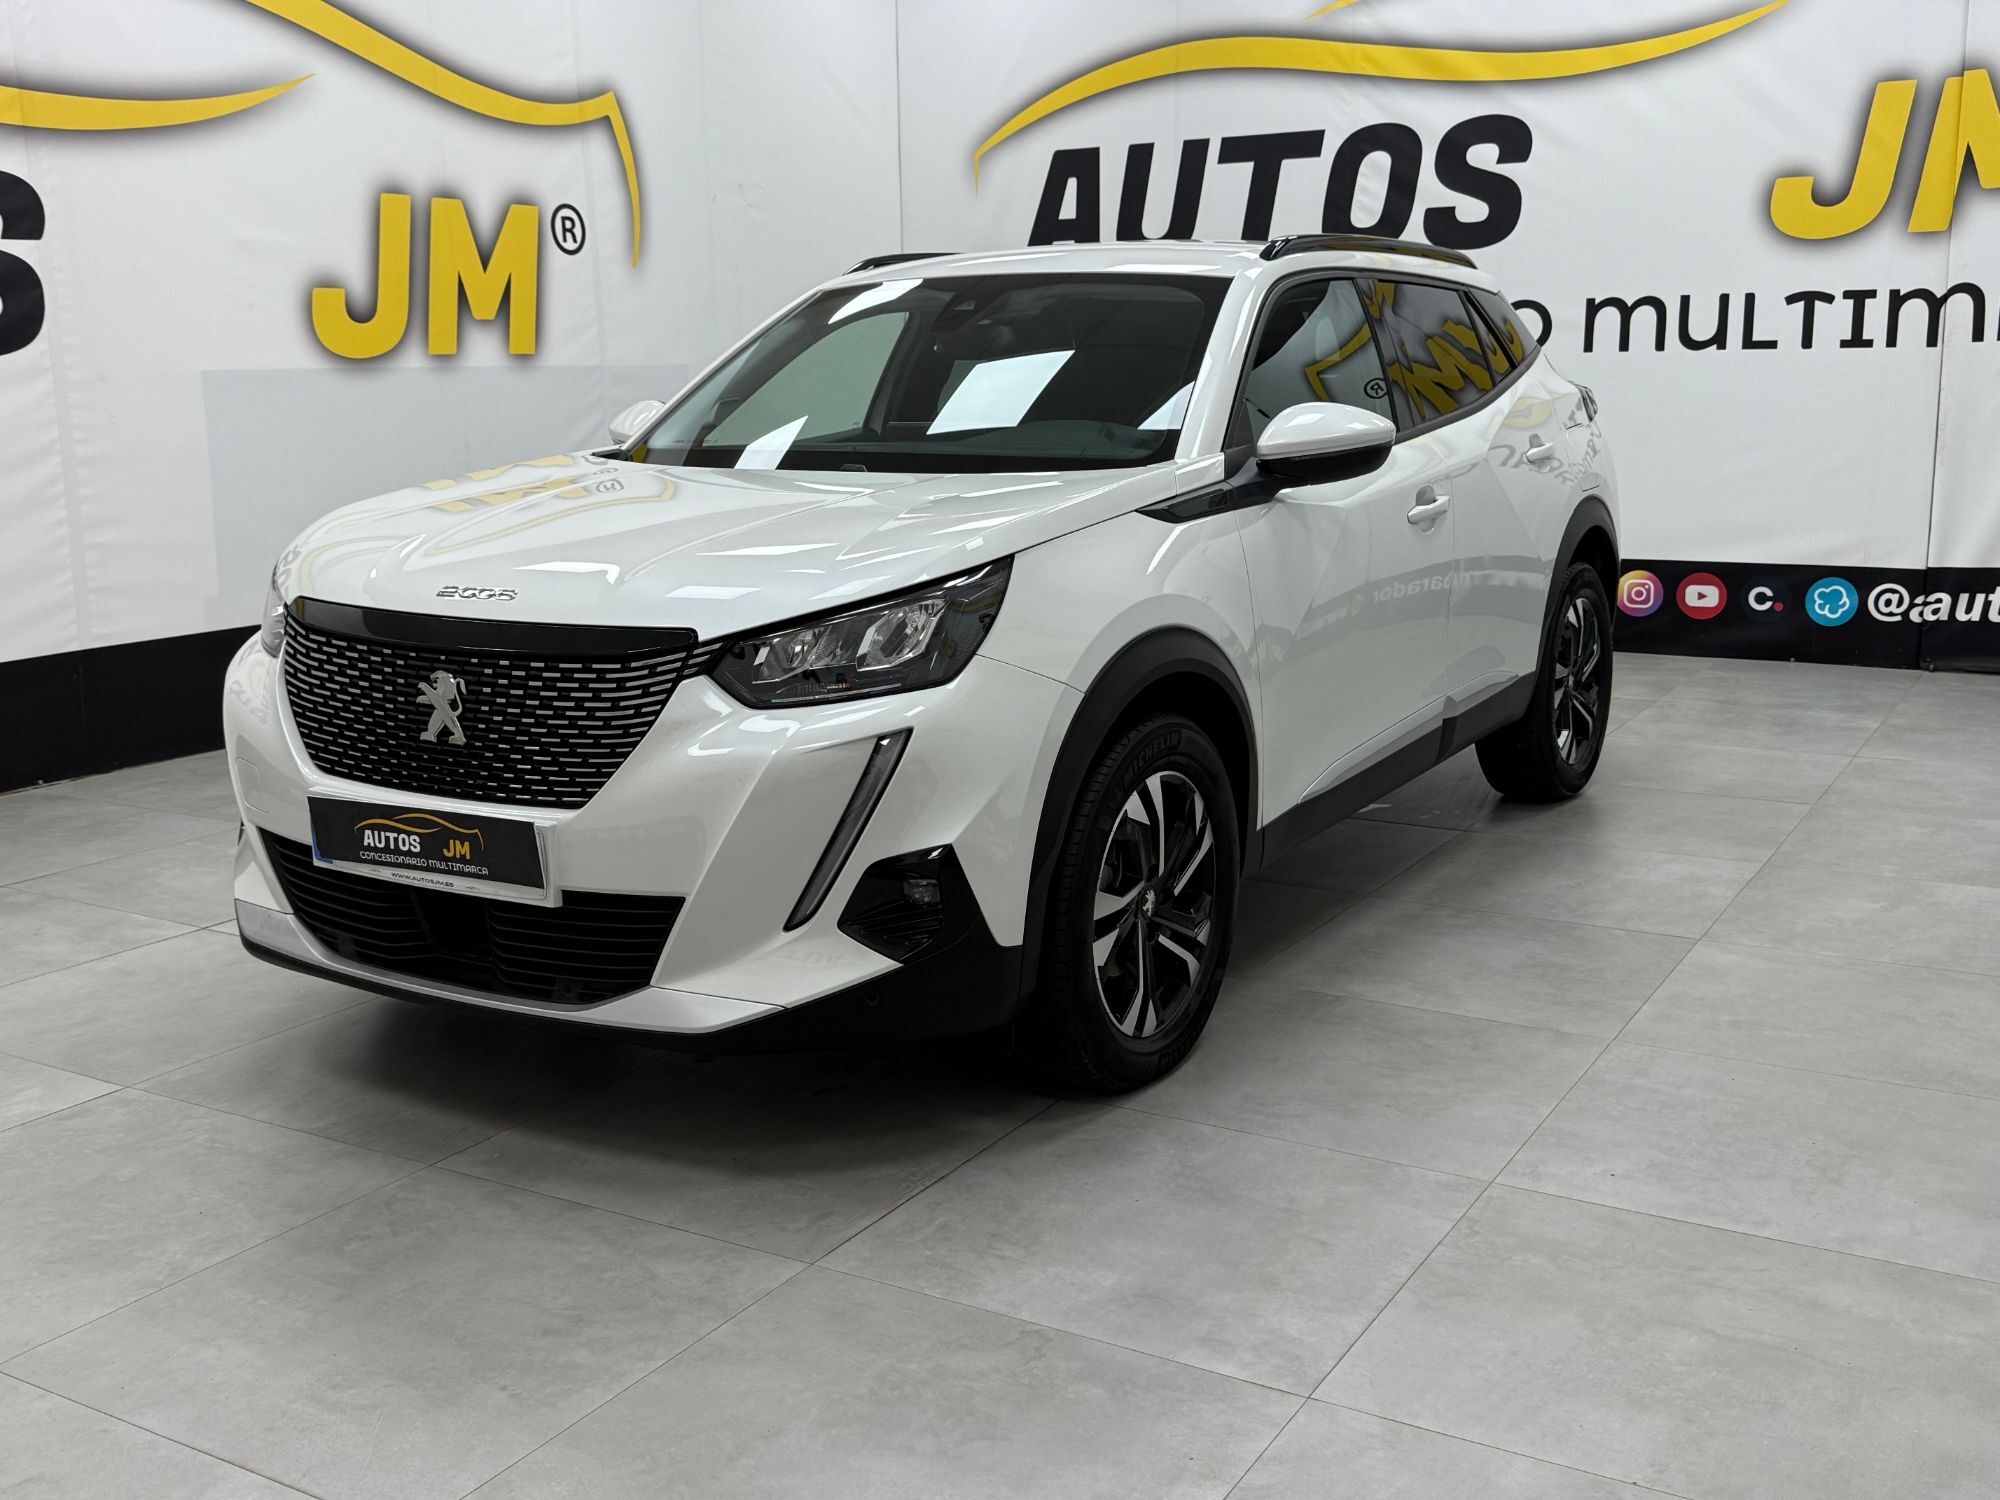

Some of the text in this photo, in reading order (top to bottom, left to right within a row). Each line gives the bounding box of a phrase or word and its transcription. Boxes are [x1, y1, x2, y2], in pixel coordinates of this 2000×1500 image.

[1027, 113, 1532, 250] AUTOS
[1583, 281, 2000, 354] MULTIM
[359, 850, 489, 876] CONCESIONARIO MULTIMARCA
[363, 829, 471, 860] AUTOS JM
